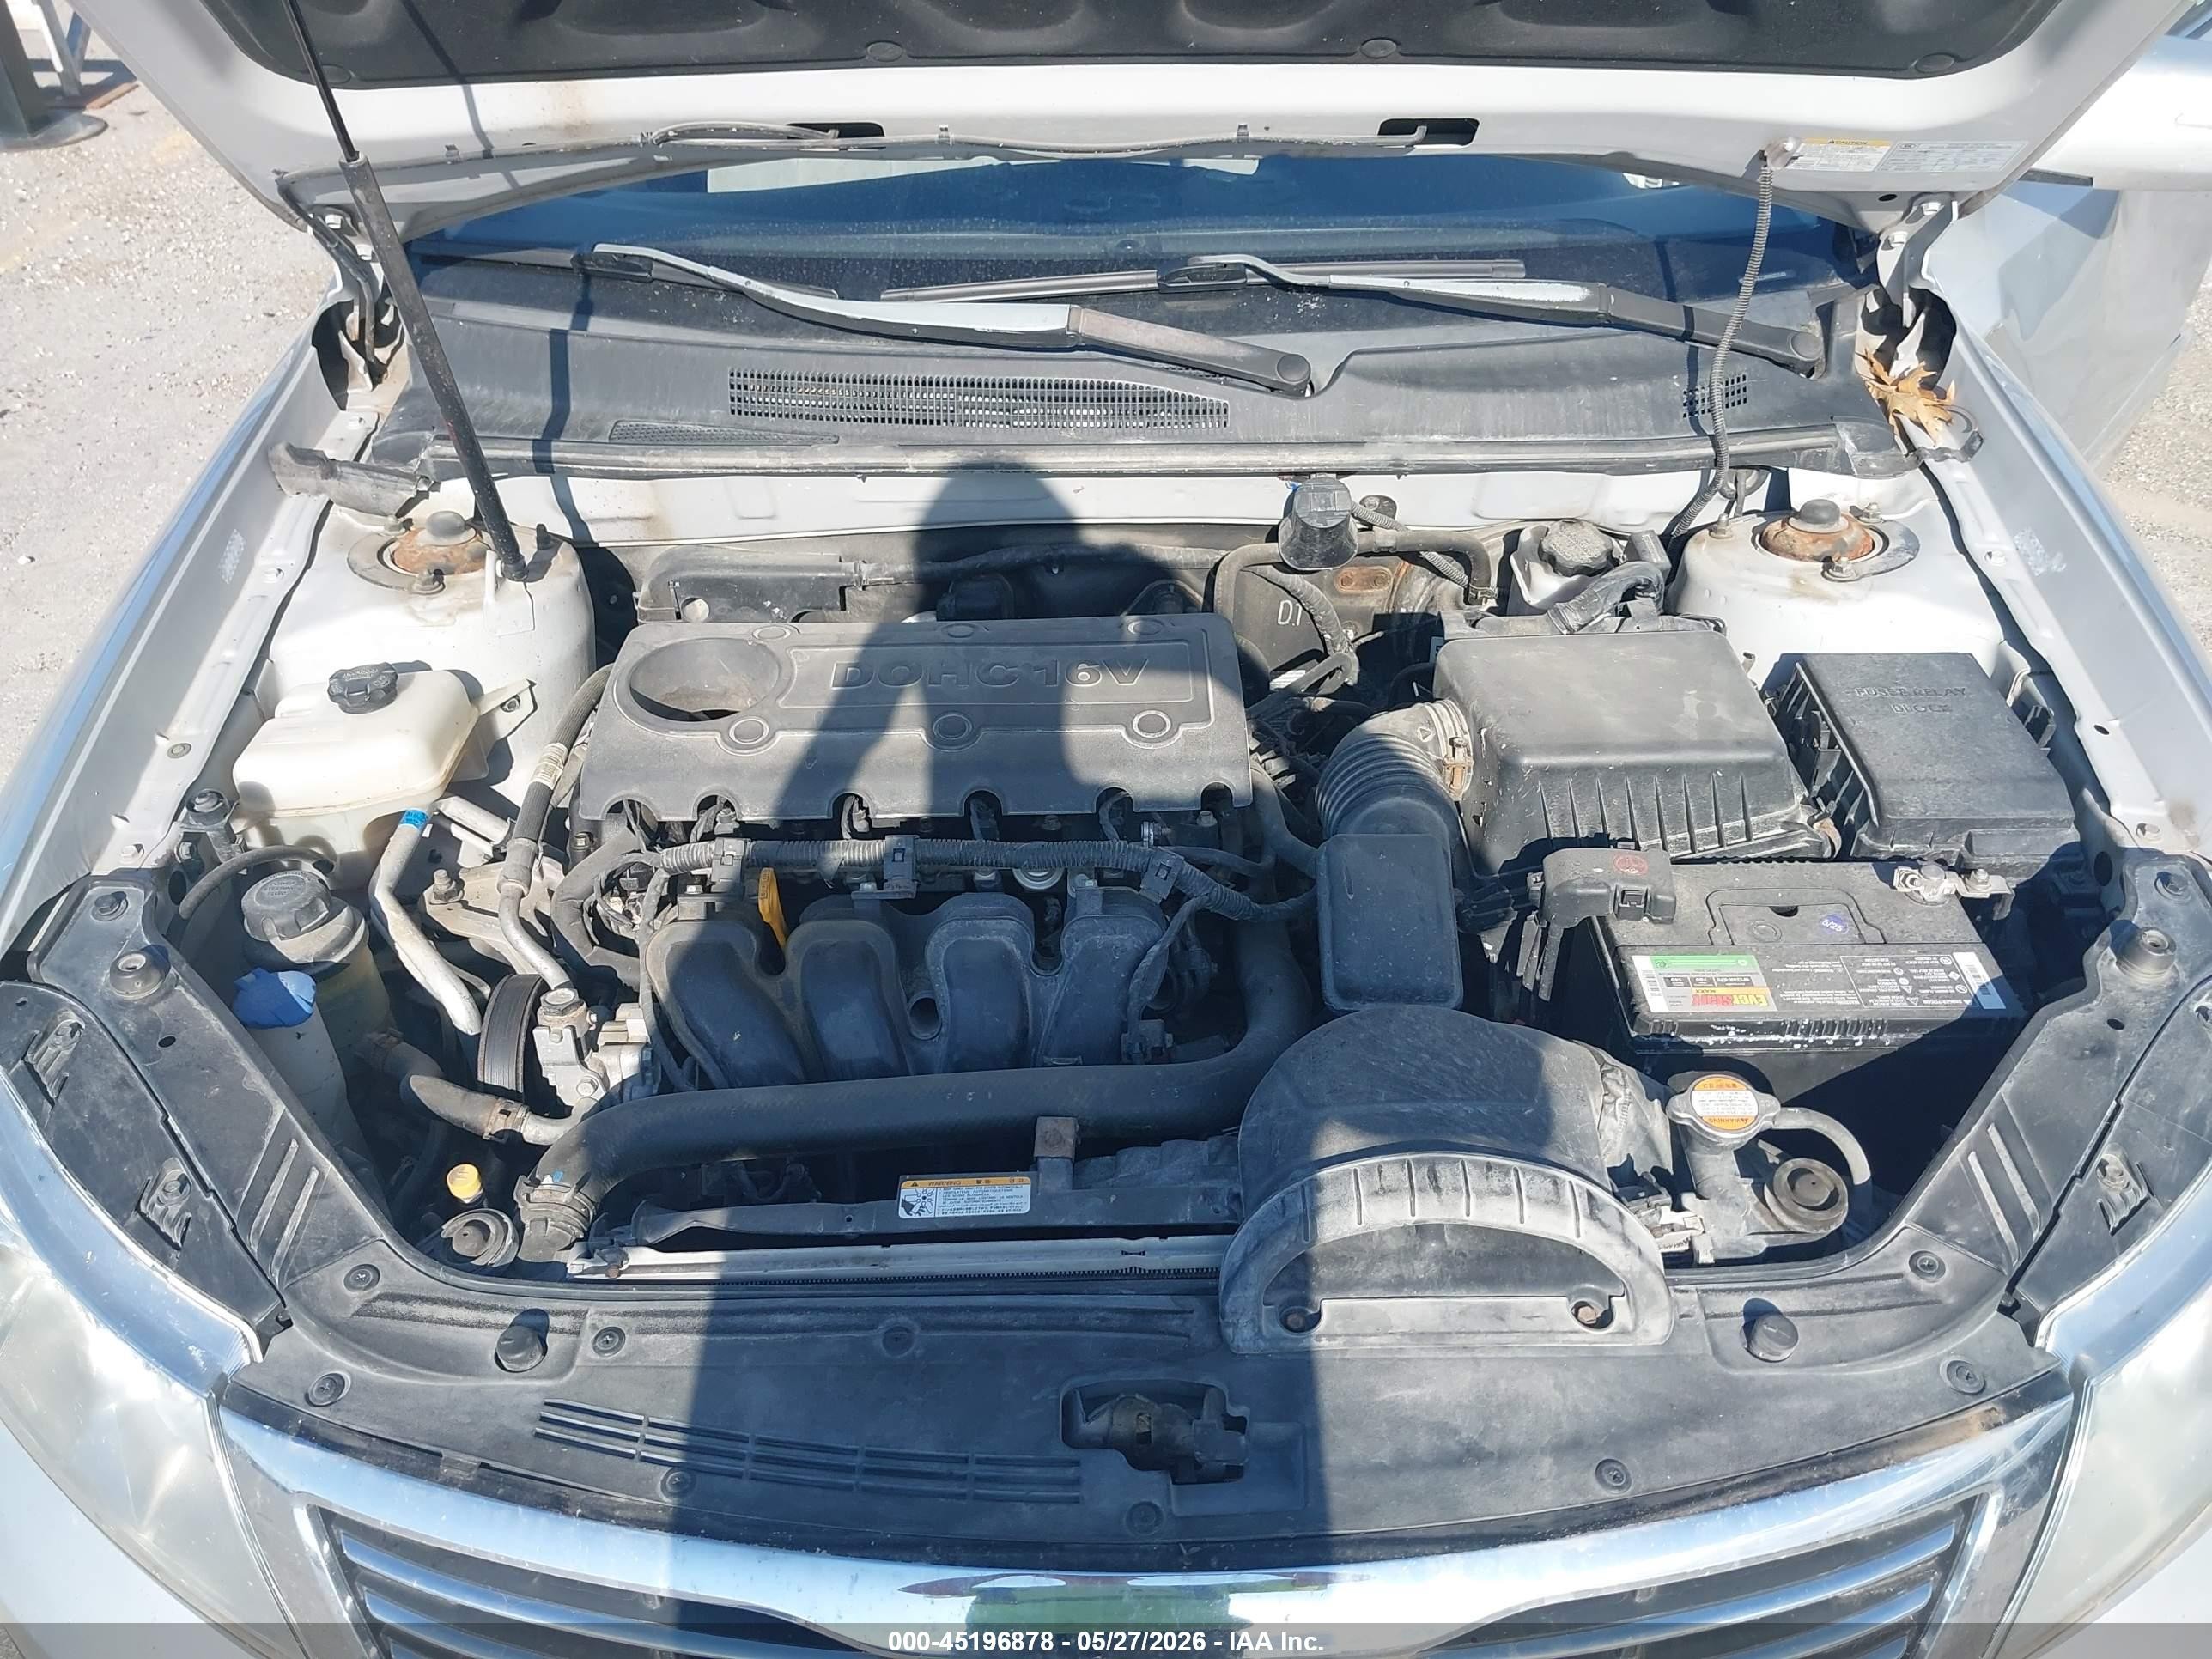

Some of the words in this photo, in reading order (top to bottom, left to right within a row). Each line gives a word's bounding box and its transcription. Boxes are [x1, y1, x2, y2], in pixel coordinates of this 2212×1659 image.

[831, 660, 1019, 690] DOHC
[1032, 659, 1150, 688] 16V
[1692, 994, 1768, 1007] EverStart
